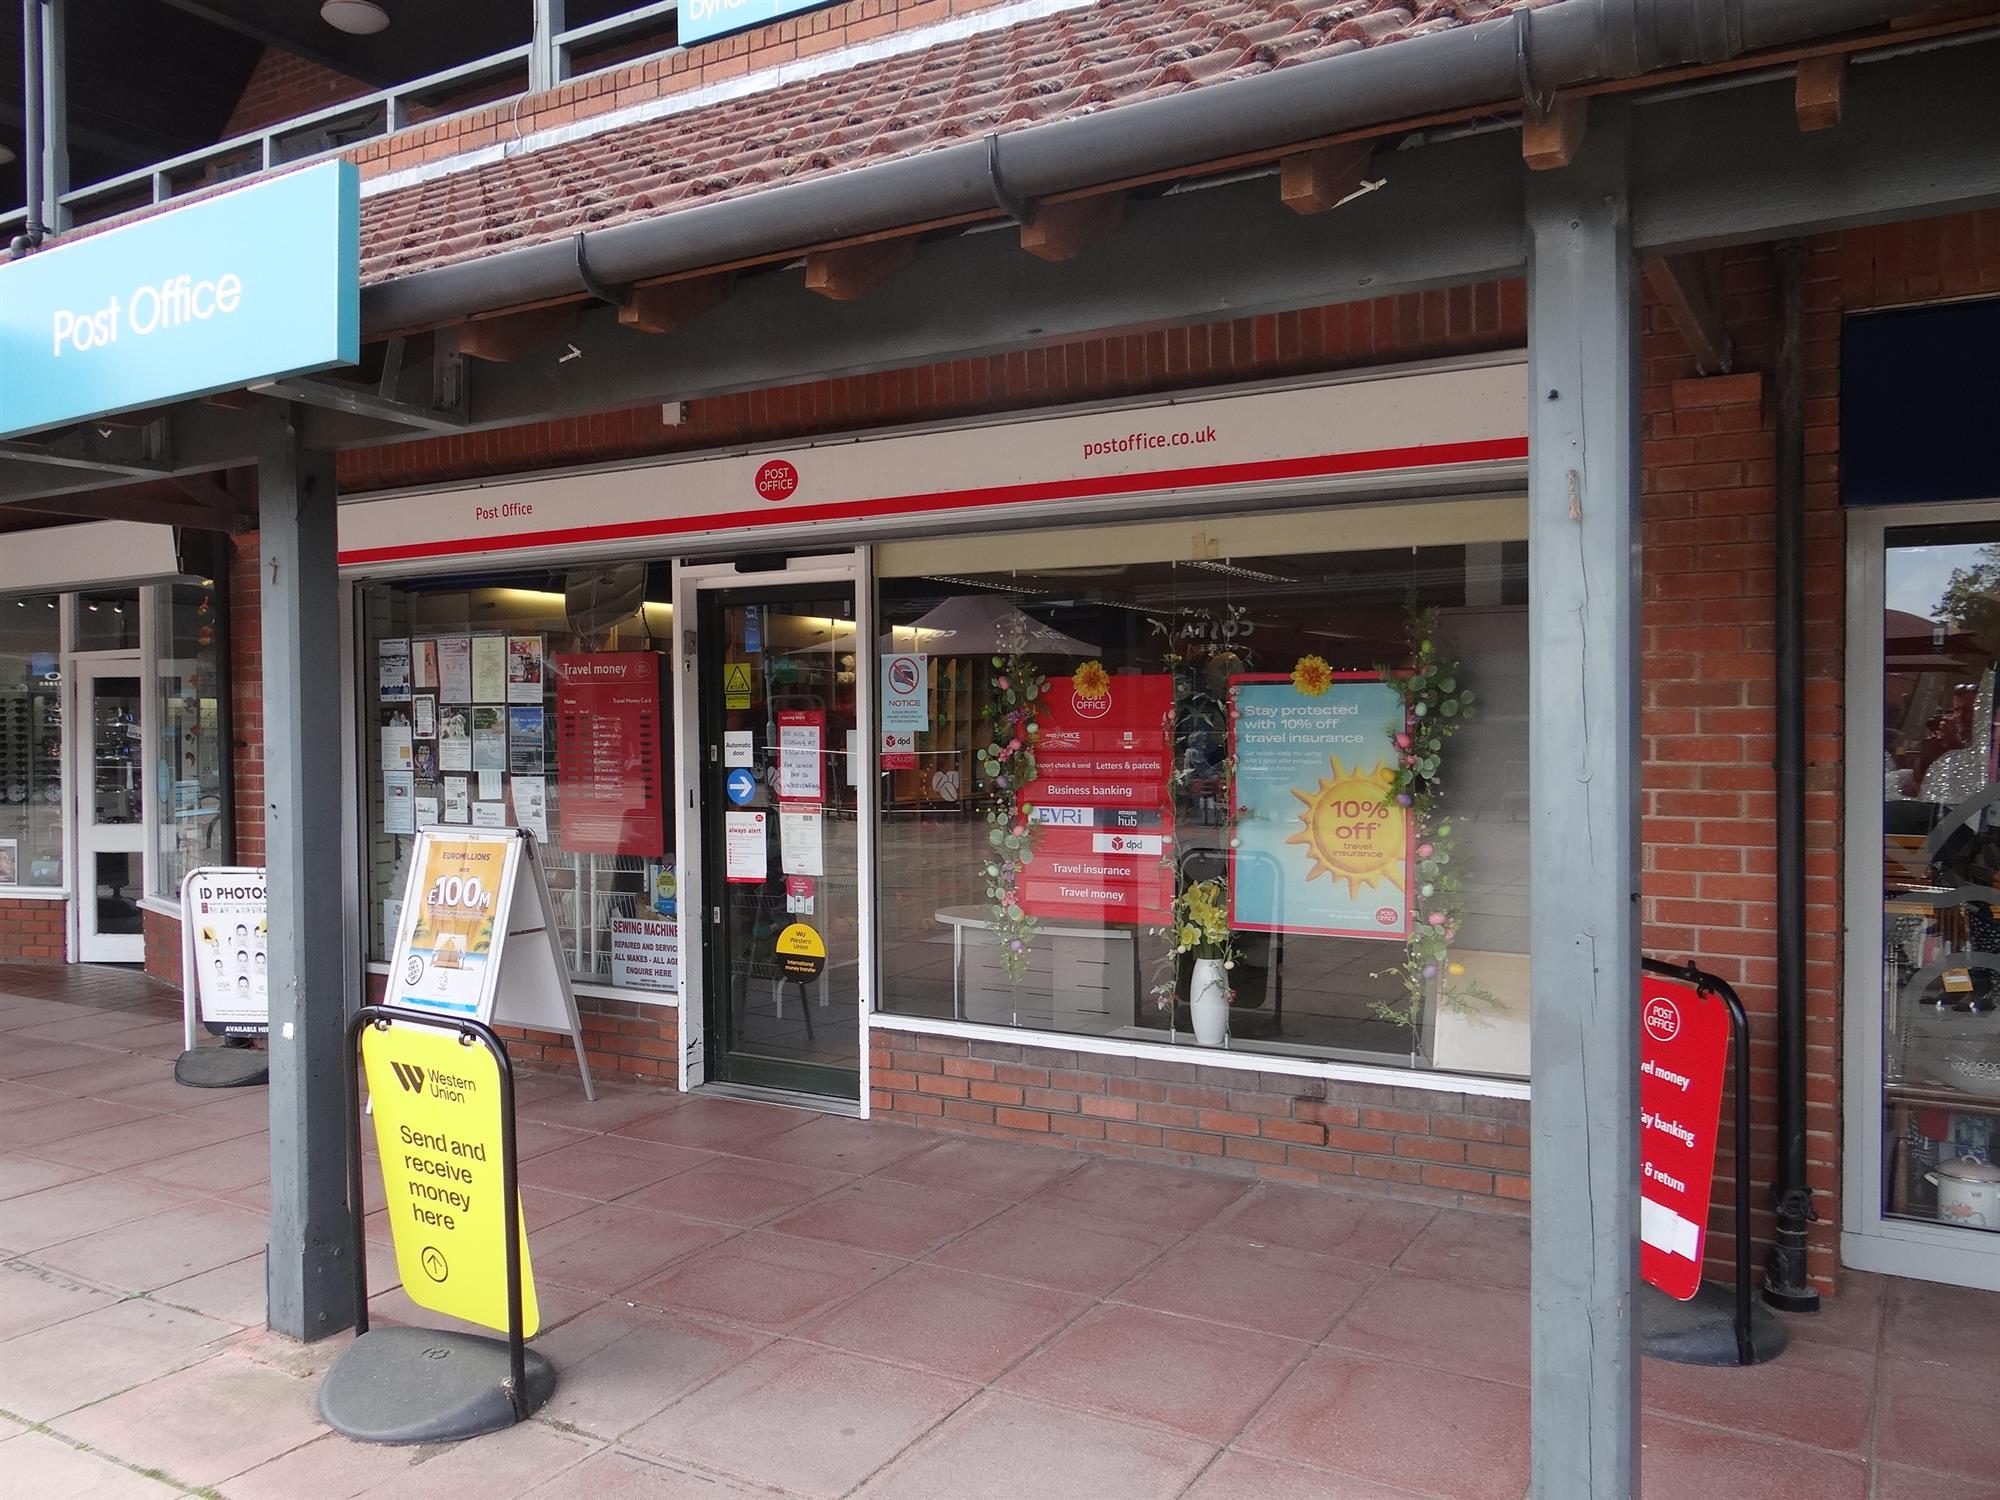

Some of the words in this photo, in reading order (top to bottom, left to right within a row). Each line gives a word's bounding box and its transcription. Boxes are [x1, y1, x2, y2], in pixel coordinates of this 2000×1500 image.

[53, 296, 121, 357] Post
[129, 273, 242, 335] Office
[1083, 426, 1217, 459] postoffice.co.uk
[764, 467, 789, 481] POST
[759, 478, 794, 492] OFFICE
[476, 506, 499, 520] Post
[502, 503, 533, 518] Office
[563, 662, 592, 675] Travel
[594, 665, 627, 678] money
[888, 699, 920, 707] NOTICE
[1076, 701, 1106, 710] OFFICE
[1244, 705, 1278, 719] Stay
[1281, 705, 1359, 718] protected
[1244, 719, 1276, 729] with
[1282, 719, 1312, 729] 10%
[897, 737, 911, 747] dpd
[1245, 732, 1286, 743] travel
[1289, 732, 1365, 743] insurance
[1096, 761, 1123, 770] Letters
[1124, 762, 1131, 770] &
[1132, 761, 1160, 772] parcels
[1047, 785, 1090, 795] Business
[1092, 785, 1132, 797] banking
[1330, 800, 1389, 820] 10%
[1117, 816, 1137, 826] hub
[1126, 839, 1143, 850] dpd
[1344, 842, 1373, 850] travel
[441, 851, 491, 862] EUROMILLIONS
[1332, 849, 1383, 858] insurance
[1052, 863, 1081, 874] Travel
[1083, 863, 1131, 876] insurance
[200, 887, 212, 899] ID
[427, 874, 492, 910] £100M
[1059, 887, 1089, 897] Travel
[1090, 889, 1124, 901] money
[613, 920, 642, 935] SEWING
[614, 940, 641, 950] REPAIRED
[642, 942, 654, 951] AND
[790, 937, 812, 945] Western
[614, 953, 626, 961] ALL
[627, 954, 648, 963] MAKES
[653, 956, 665, 964] ALL
[787, 959, 815, 967] International
[626, 967, 653, 976] ENQUIRE
[654, 968, 672, 978] HERE
[1653, 1006, 1673, 1019] POST
[1647, 1016, 1675, 1033] OFFICE
[427, 1068, 477, 1092] Western
[1655, 1066, 1691, 1092] money
[429, 1083, 465, 1104] Union
[1641, 1107, 1654, 1129] ay
[1654, 1113, 1696, 1148] banking
[400, 1125, 448, 1153] Send
[451, 1140, 486, 1162] and
[404, 1154, 473, 1184] receive
[1645, 1162, 1653, 1177] &
[1653, 1169, 1685, 1193] return
[409, 1181, 471, 1213] money
[412, 1203, 456, 1230] here
